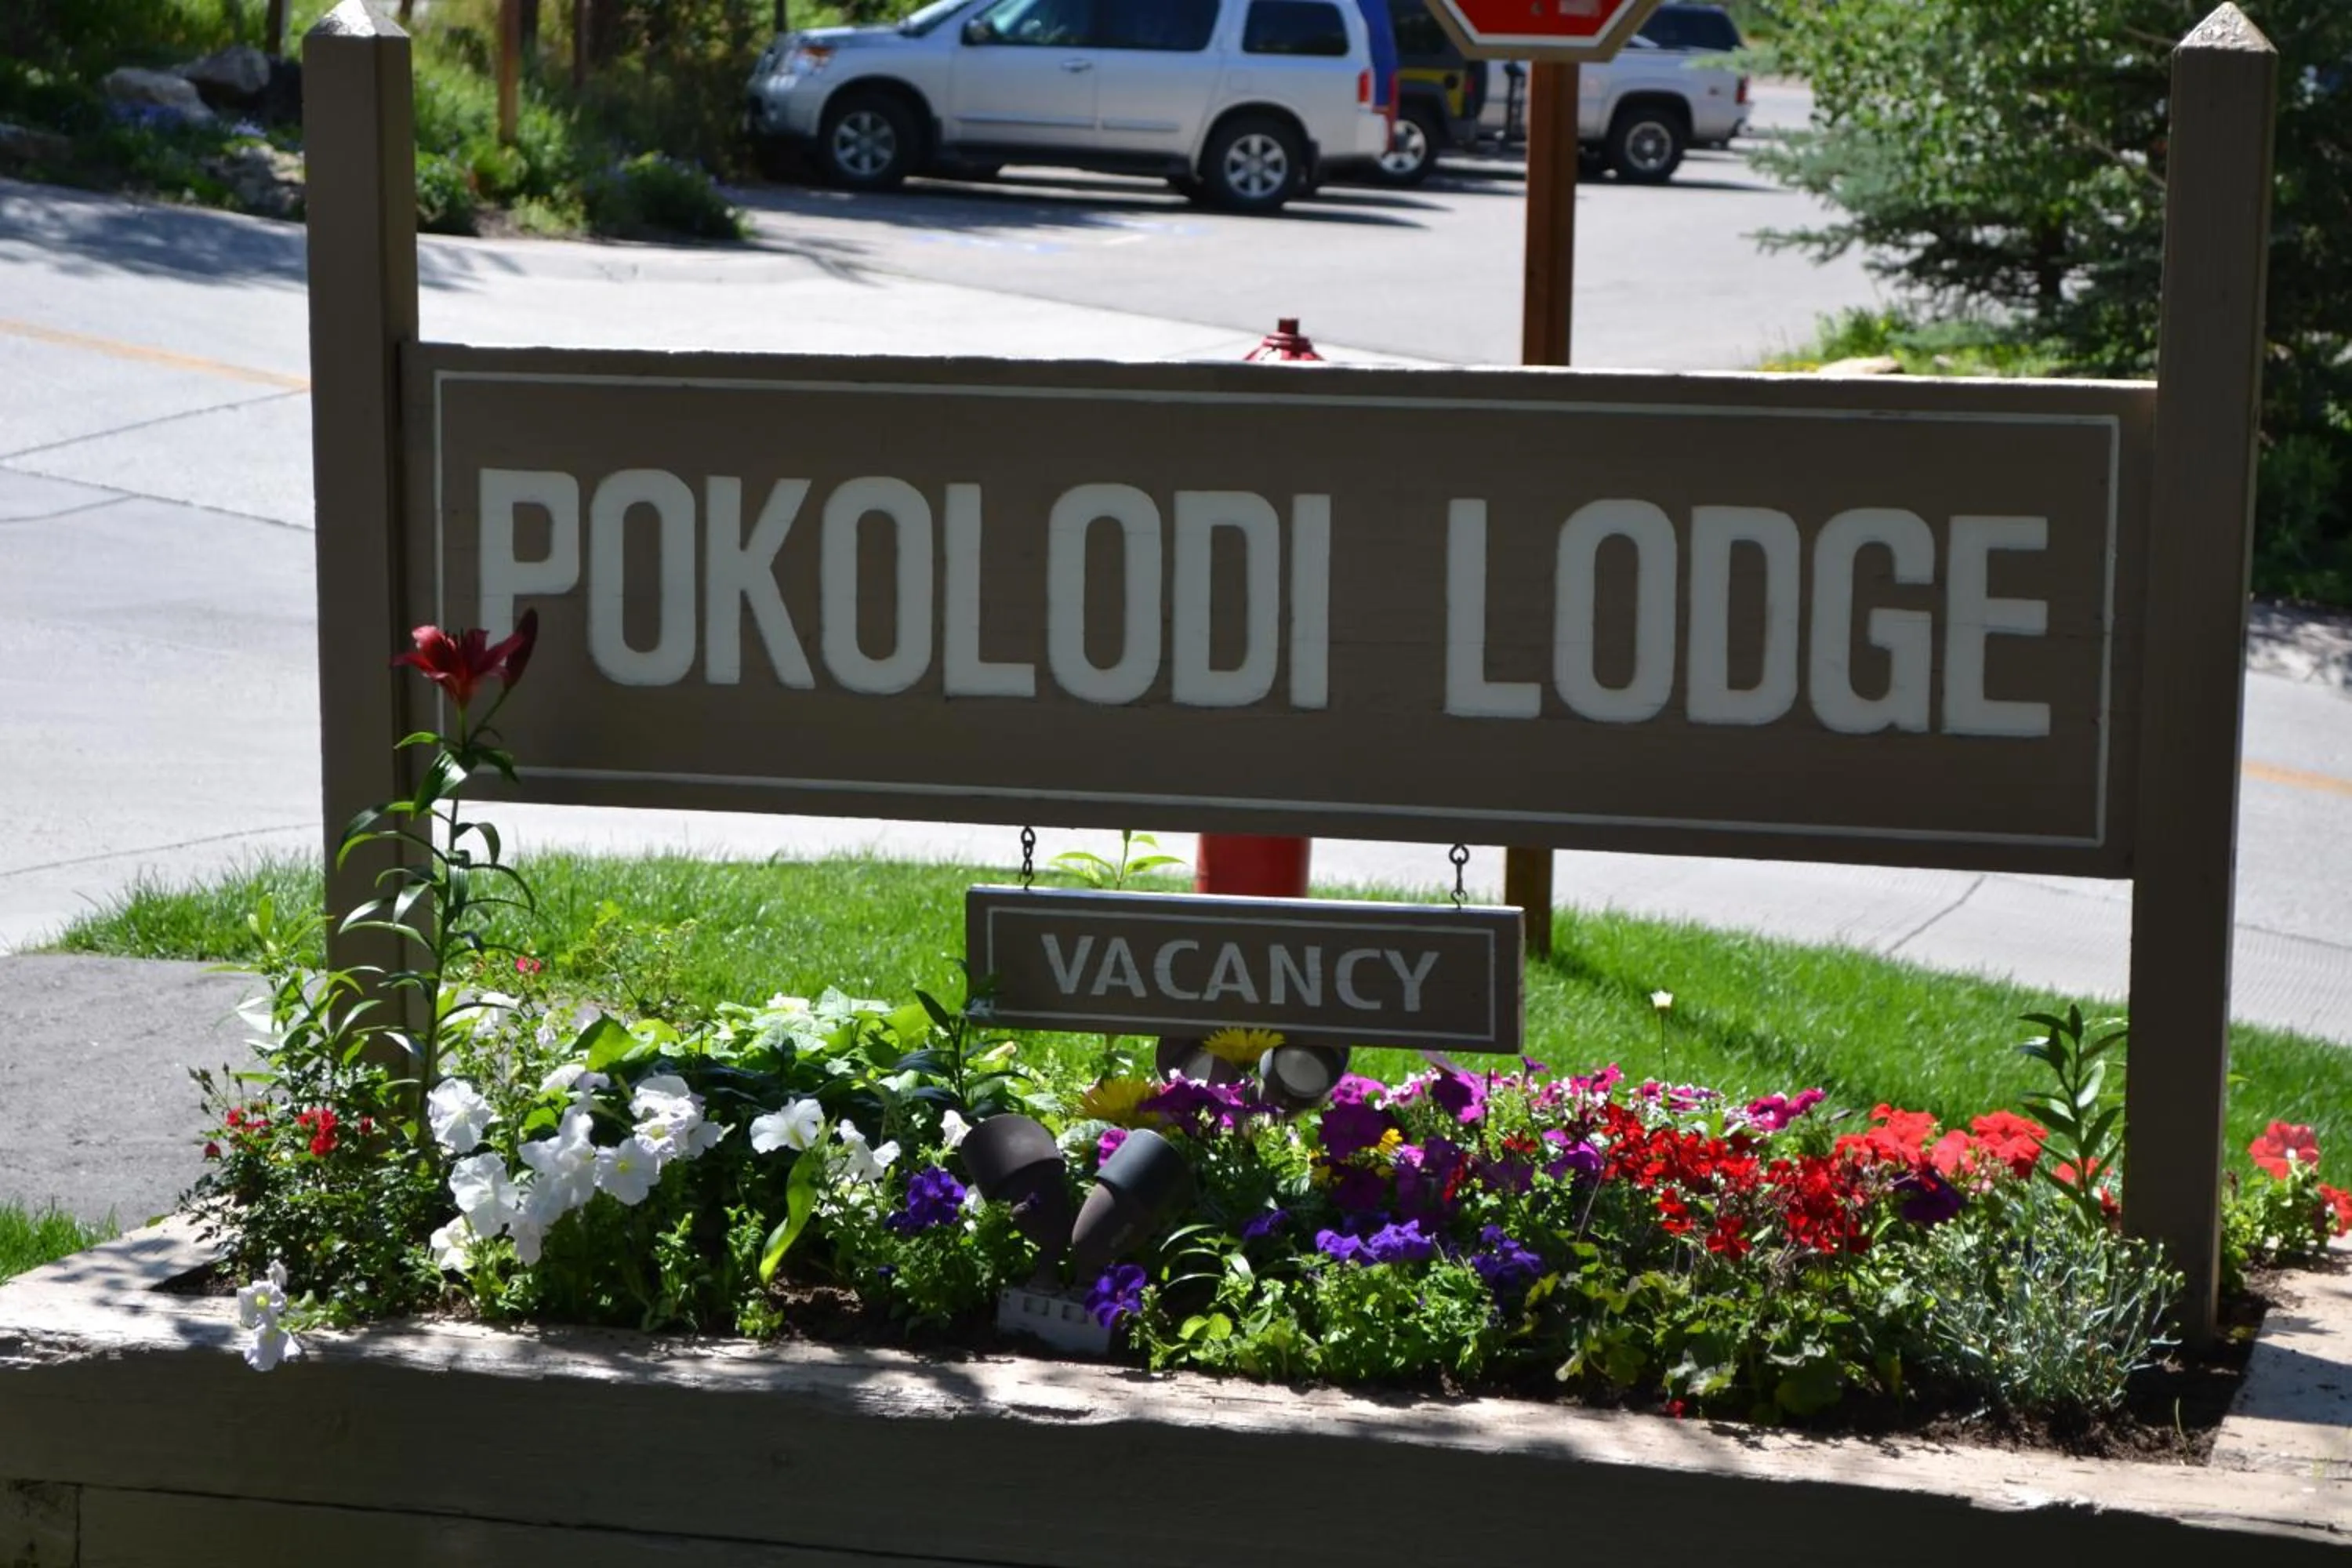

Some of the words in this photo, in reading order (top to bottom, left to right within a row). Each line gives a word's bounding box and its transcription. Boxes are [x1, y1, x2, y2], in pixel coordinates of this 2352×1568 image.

[479, 468, 1331, 710] POKOLODI
[1444, 499, 2051, 736] LODGE
[1041, 934, 1439, 1011] VACANCY
